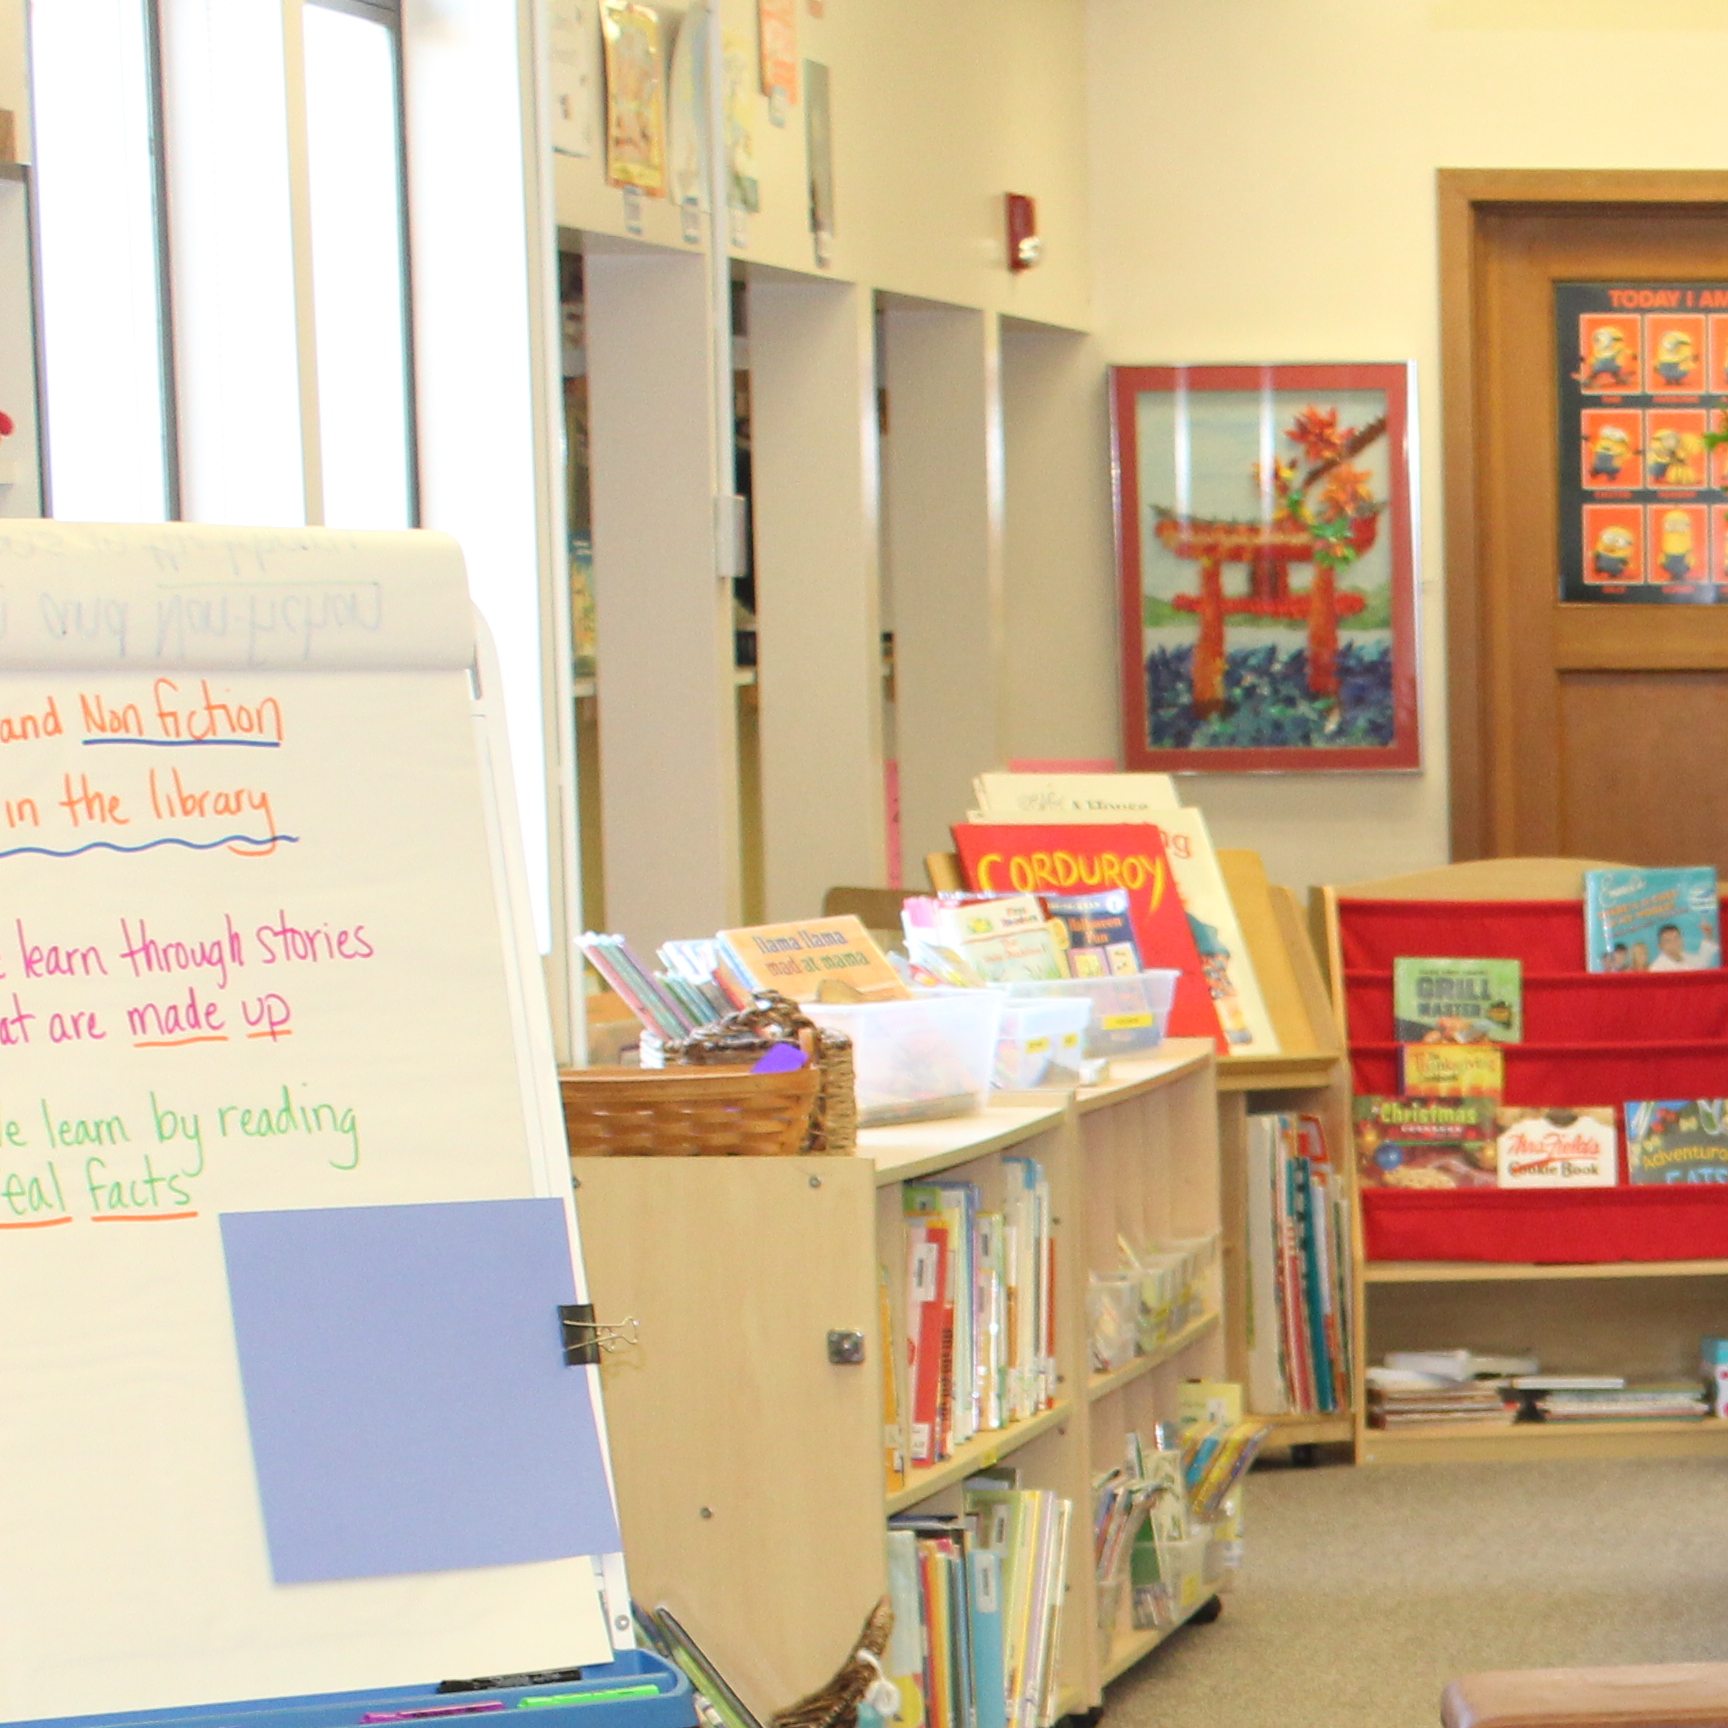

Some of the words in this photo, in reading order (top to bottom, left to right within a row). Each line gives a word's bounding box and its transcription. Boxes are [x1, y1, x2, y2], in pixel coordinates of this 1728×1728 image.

[1608, 290, 1682, 308] TODAY
[1686, 290, 1693, 308] I
[1, 695, 63, 744] and
[79, 692, 144, 737] Non
[154, 677, 284, 742] fiction
[5, 798, 40, 828] in
[58, 772, 130, 827] the
[149, 766, 278, 857] library
[977, 850, 1165, 919] CORDUROY
[16, 918, 108, 978] learn
[119, 913, 244, 989] through
[256, 908, 374, 964] stories
[752, 935, 800, 953] llama
[799, 929, 848, 948] llama
[1085, 933, 1110, 944] Fun
[765, 957, 802, 976] mad
[801, 955, 820, 972] at
[820, 951, 870, 970] mama
[1416, 976, 1493, 1001] GRILL
[49, 1010, 107, 1042] are
[127, 986, 226, 1036] made
[242, 993, 291, 1042] up
[41, 1098, 130, 1149] learn
[149, 1090, 204, 1178] by
[218, 1082, 358, 1170] reading
[1380, 1101, 1478, 1125] Christmas
[85, 1155, 191, 1212] facts
[1560, 1160, 1599, 1176] Book
